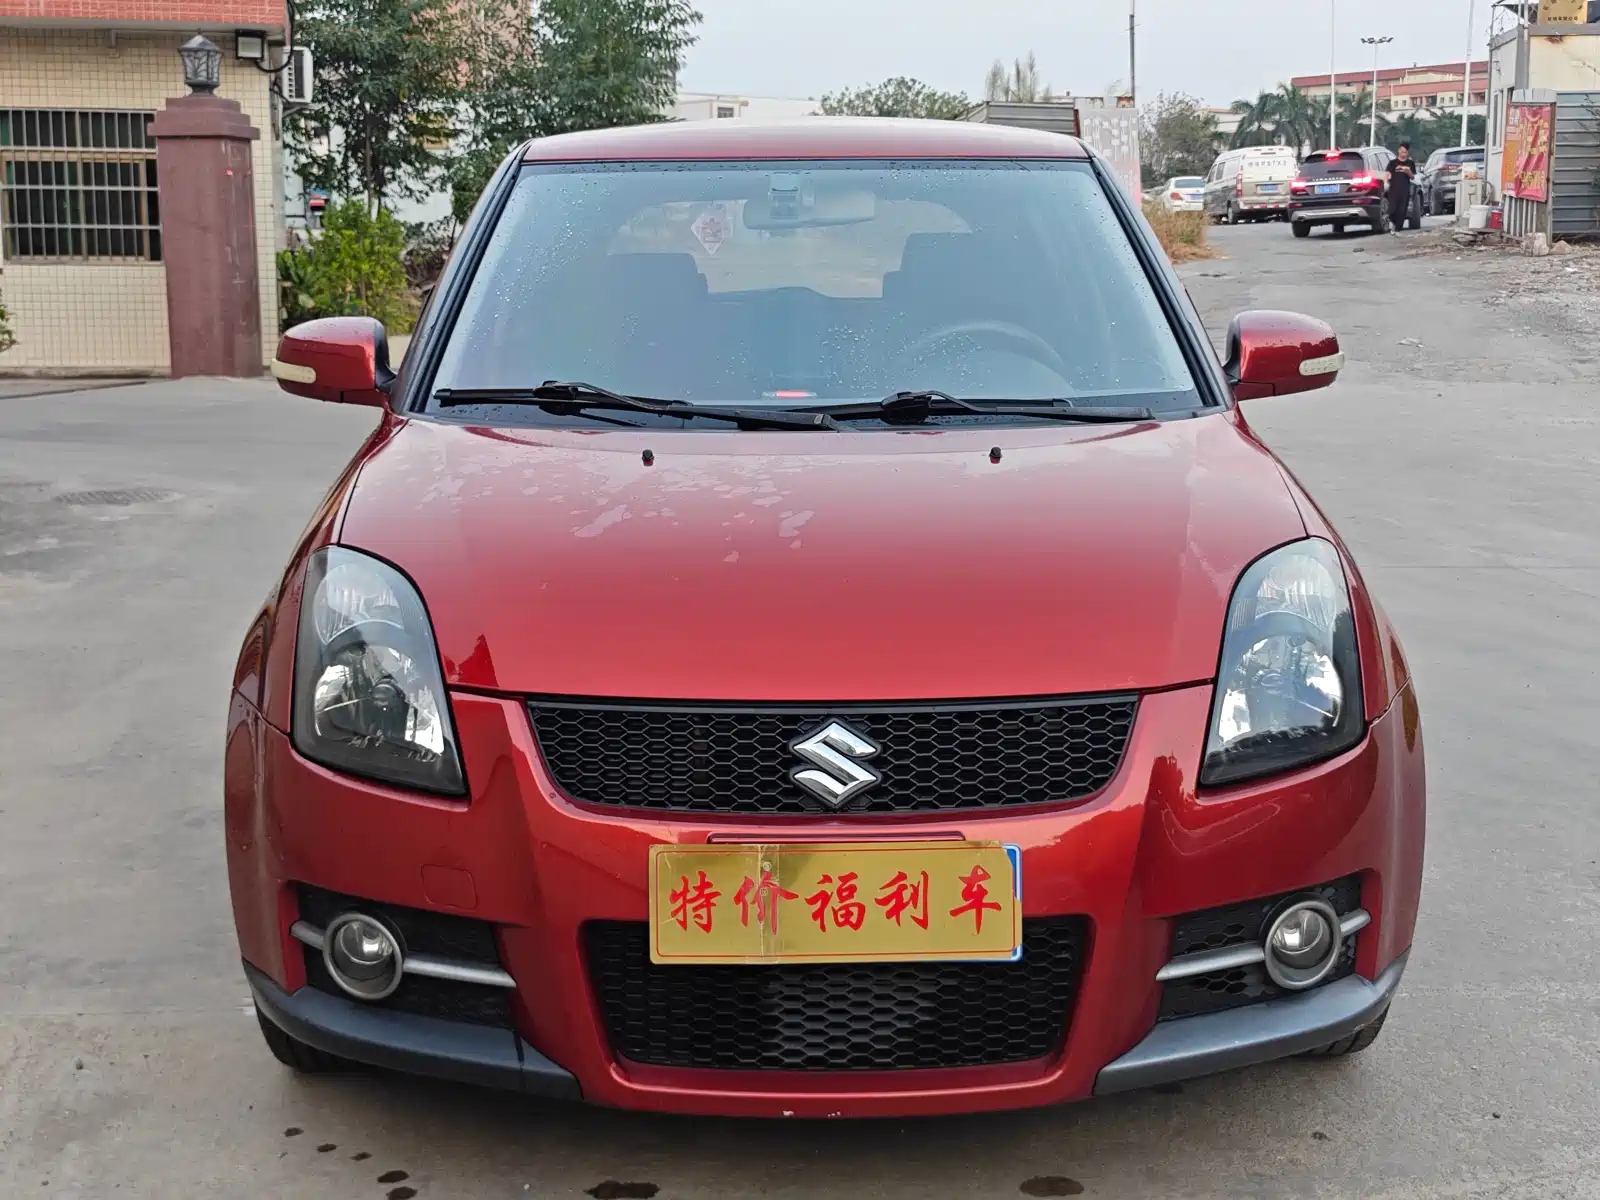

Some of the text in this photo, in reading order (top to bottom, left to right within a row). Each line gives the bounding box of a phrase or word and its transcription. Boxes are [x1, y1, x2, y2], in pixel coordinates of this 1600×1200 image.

[669, 864, 1002, 935] 特价福利车
